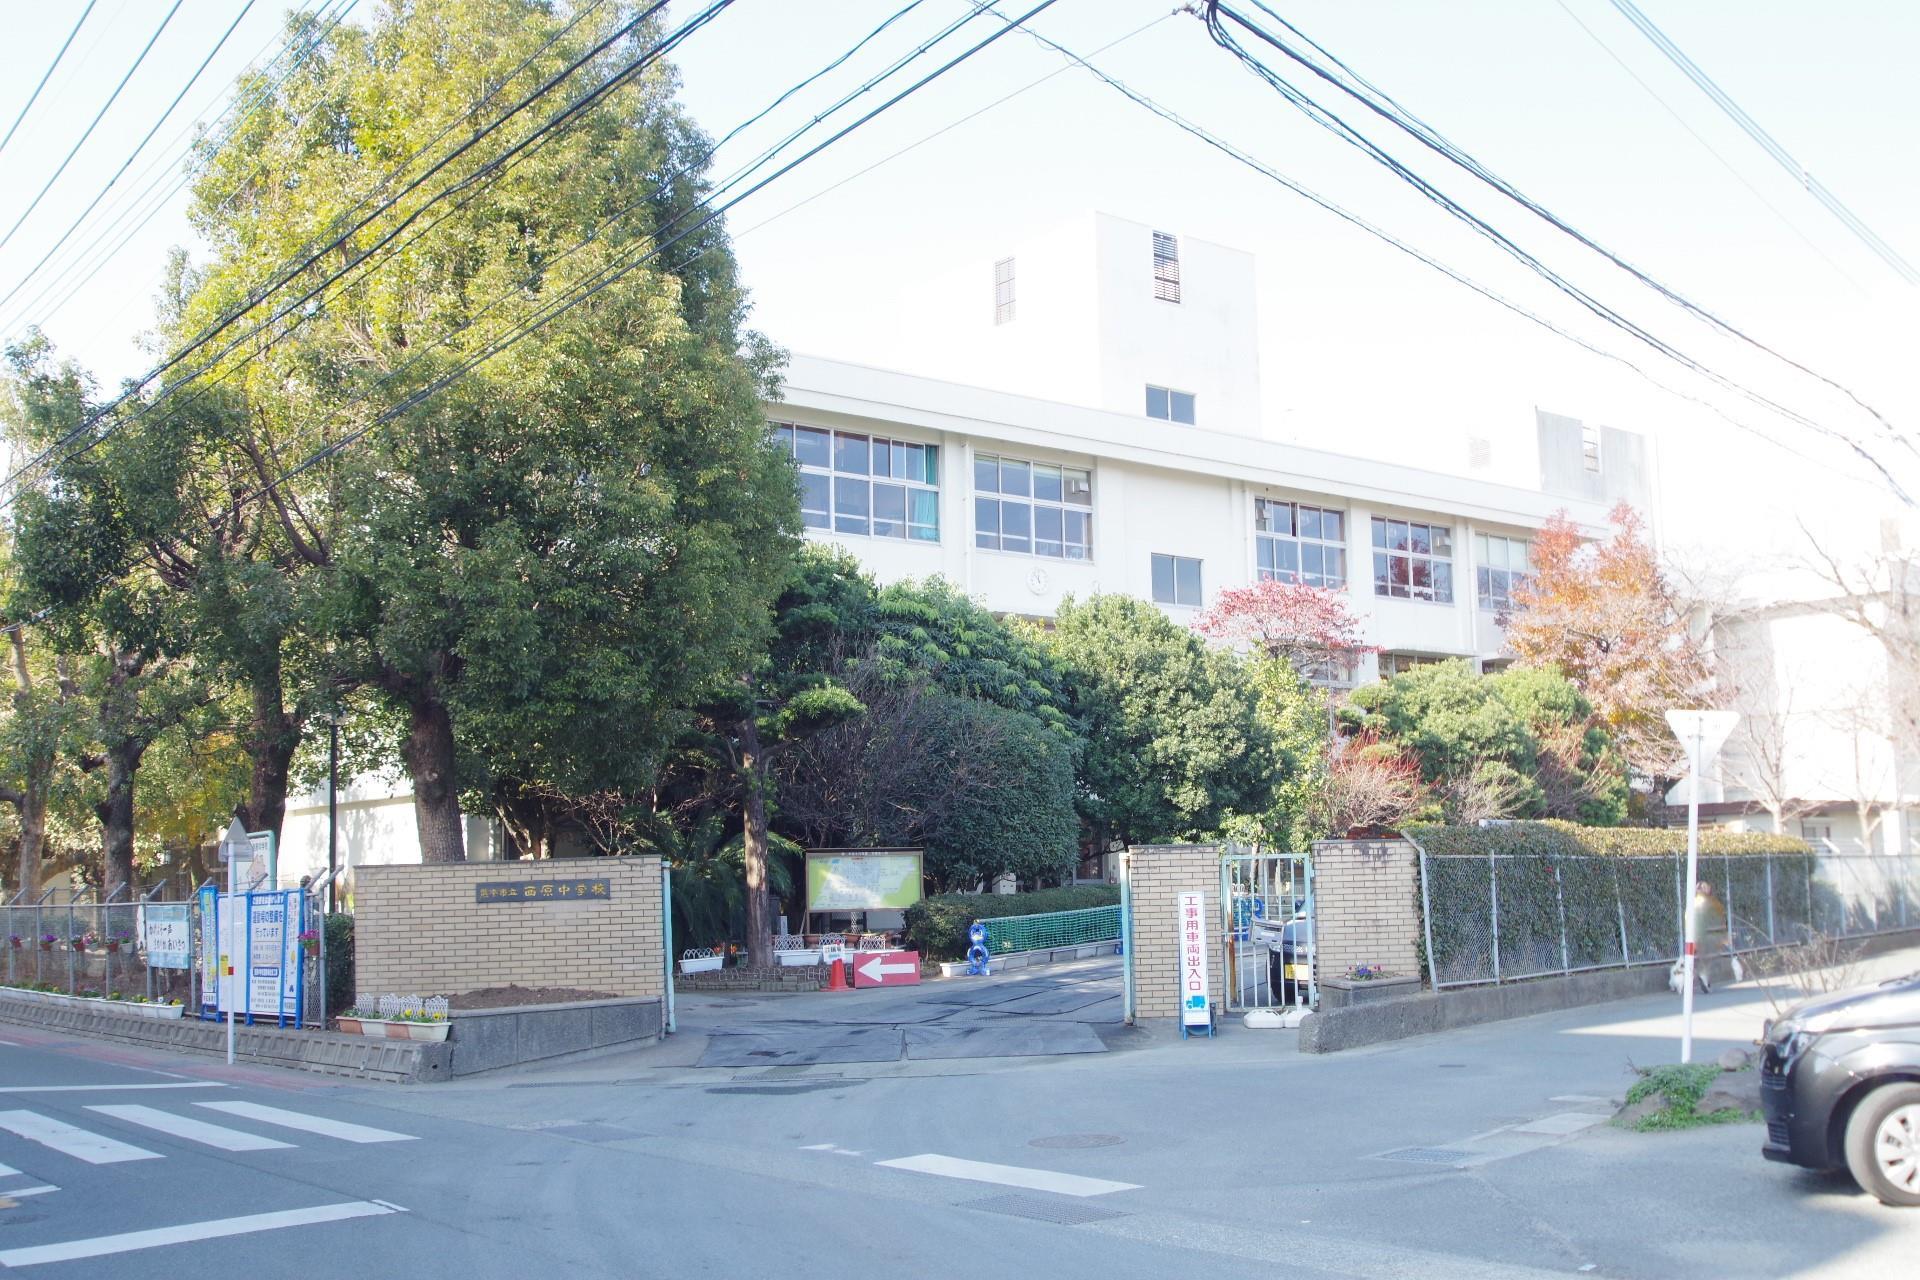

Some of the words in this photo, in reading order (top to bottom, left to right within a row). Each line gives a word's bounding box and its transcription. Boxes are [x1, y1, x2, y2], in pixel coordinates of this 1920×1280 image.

[1185, 897, 1201, 991] 工事用車両出入口
